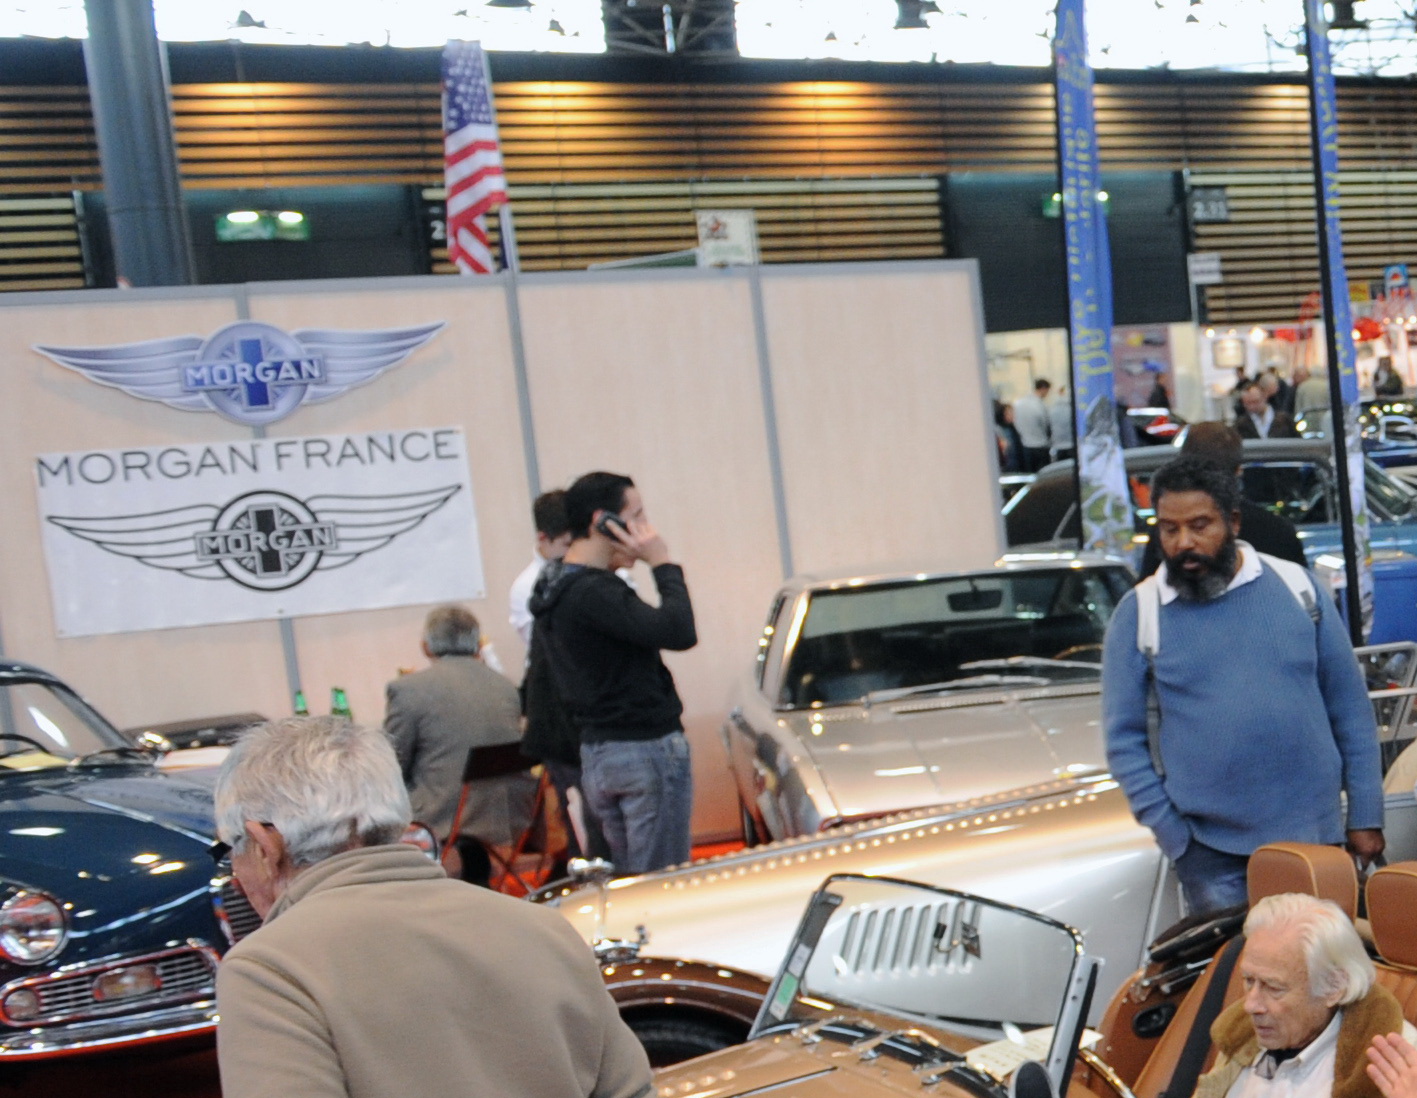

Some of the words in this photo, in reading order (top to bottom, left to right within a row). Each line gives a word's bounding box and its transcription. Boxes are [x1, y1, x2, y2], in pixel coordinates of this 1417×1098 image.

[185, 357, 321, 388] MORGAN
[36, 443, 261, 488] MORGAN
[273, 429, 460, 472] FRANCE
[200, 526, 332, 557] MORGAN
